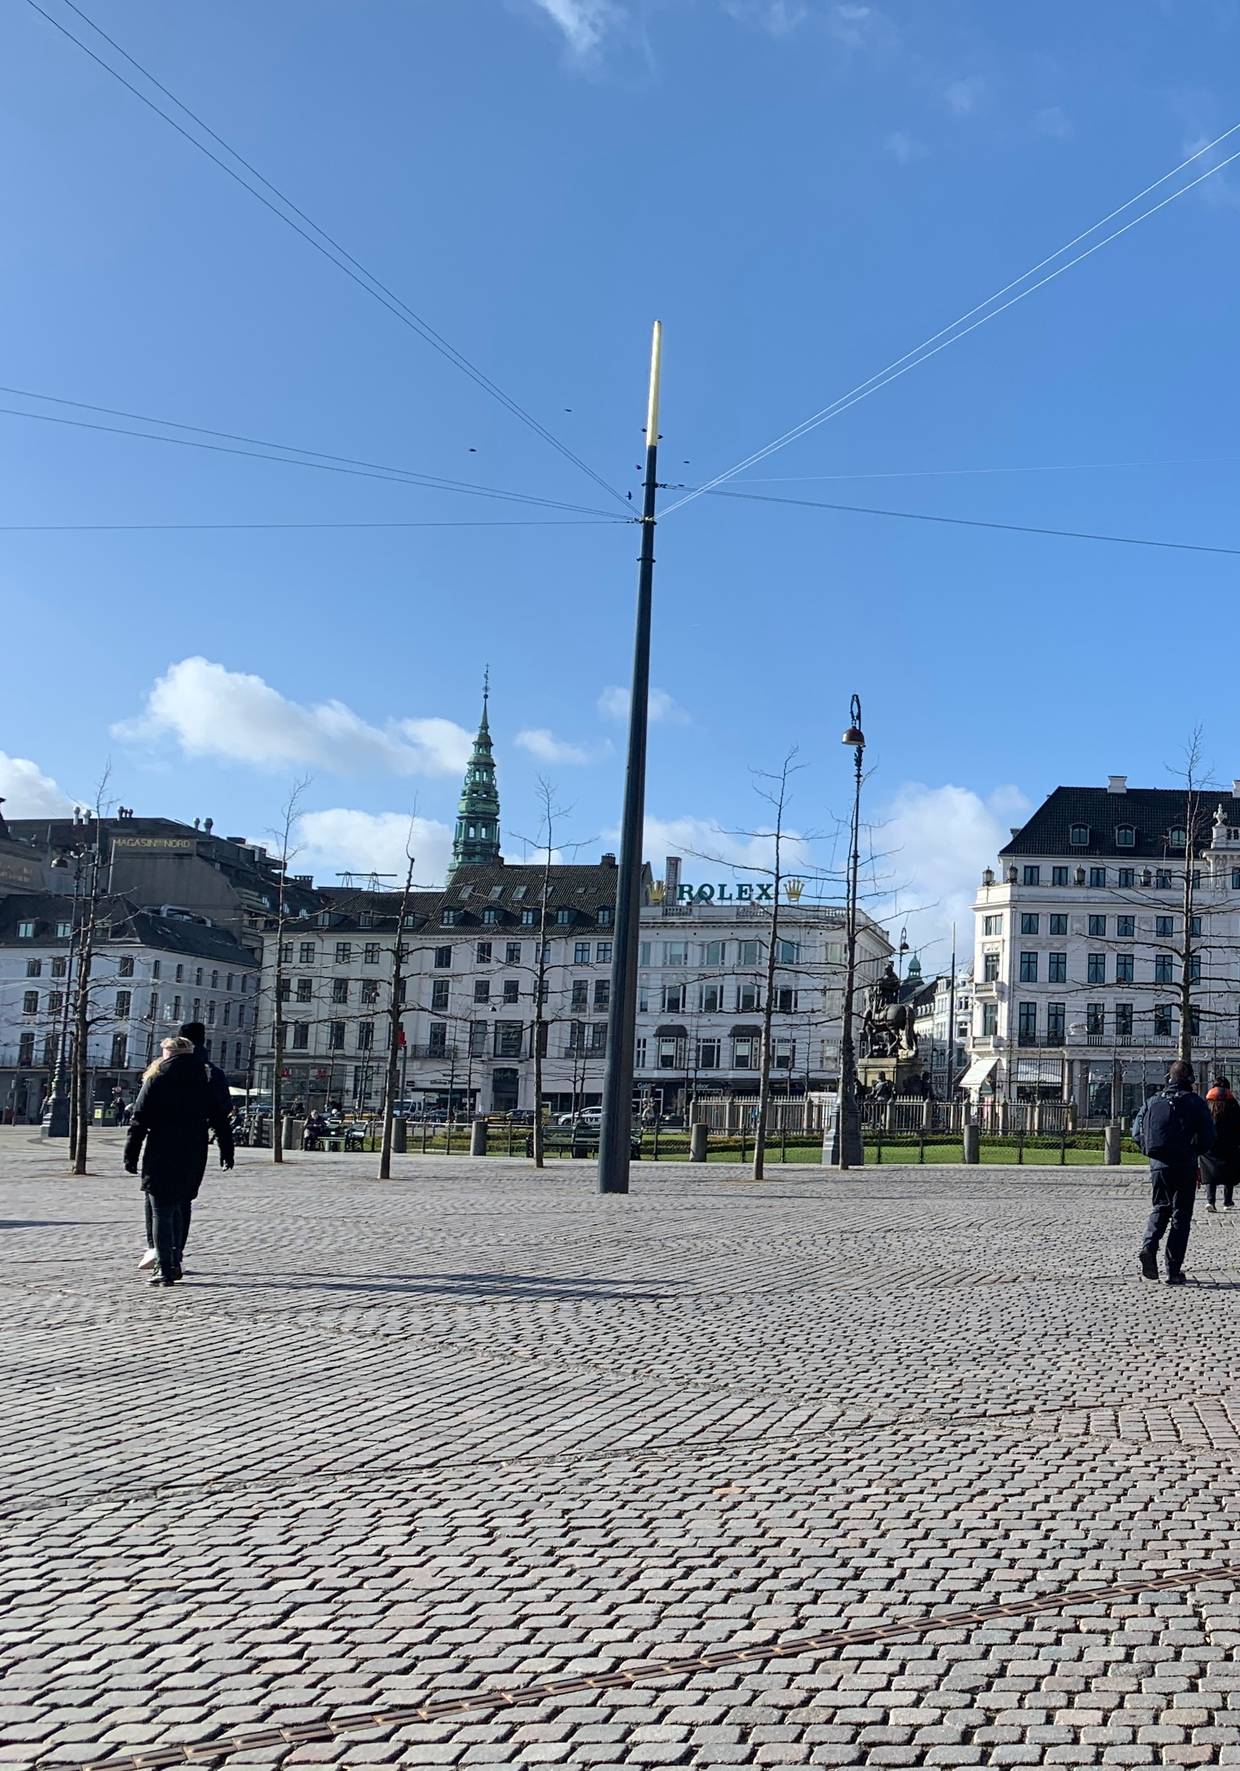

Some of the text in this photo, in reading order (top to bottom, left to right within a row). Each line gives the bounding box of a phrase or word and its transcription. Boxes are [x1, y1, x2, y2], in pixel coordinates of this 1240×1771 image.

[114, 838, 157, 848] MAGASIN
[164, 839, 190, 848] NORD
[677, 883, 774, 901] ROLEX
